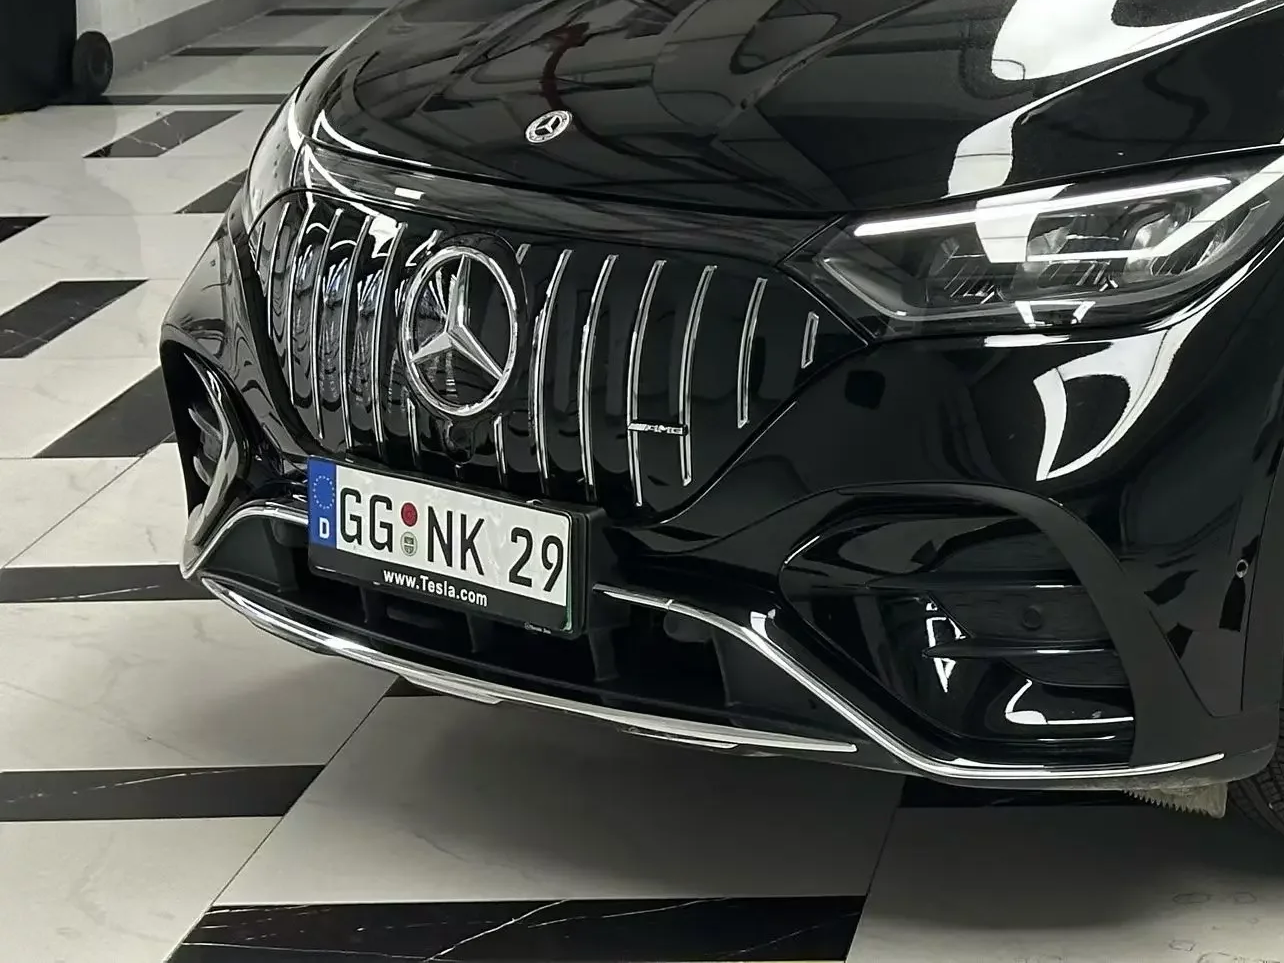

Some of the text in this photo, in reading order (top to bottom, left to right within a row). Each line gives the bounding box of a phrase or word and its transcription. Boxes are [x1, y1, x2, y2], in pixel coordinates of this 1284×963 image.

[319, 517, 330, 540] D
[340, 487, 565, 593] GG NK 29
[383, 569, 488, 608] www.Tesla.com
